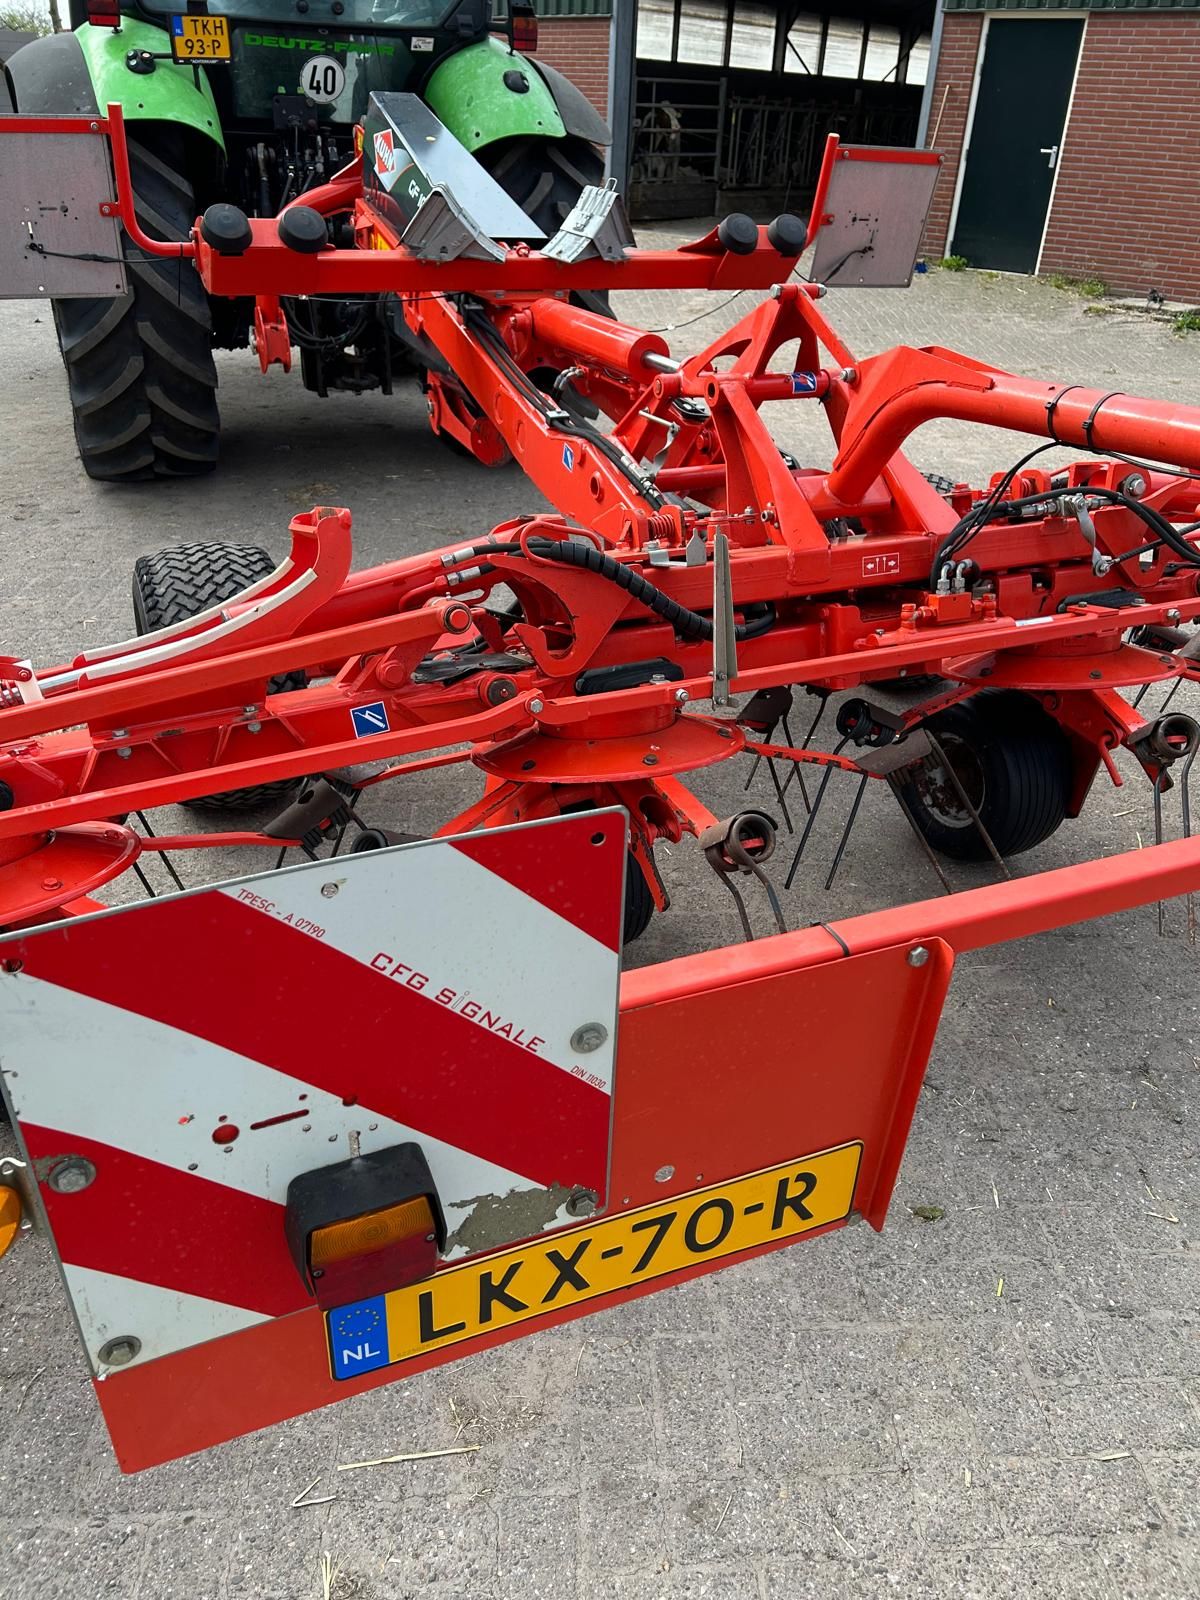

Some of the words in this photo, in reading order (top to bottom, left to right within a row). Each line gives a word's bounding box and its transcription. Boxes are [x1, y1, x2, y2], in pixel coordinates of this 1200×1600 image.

[190, 19, 224, 36] TKH
[185, 38, 221, 55] 93-P
[309, 65, 336, 96] 40
[375, 134, 396, 172] KUHN
[408, 179, 421, 198] GF
[237, 888, 275, 912] TPESC
[282, 913, 294, 923] A
[295, 918, 326, 938] 07190
[369, 952, 429, 990] CFG
[570, 1065, 588, 1078] DIN
[586, 1073, 607, 1089] 11030
[418, 1171, 818, 1344] LKX-70-R
[342, 1342, 381, 1365] NL
